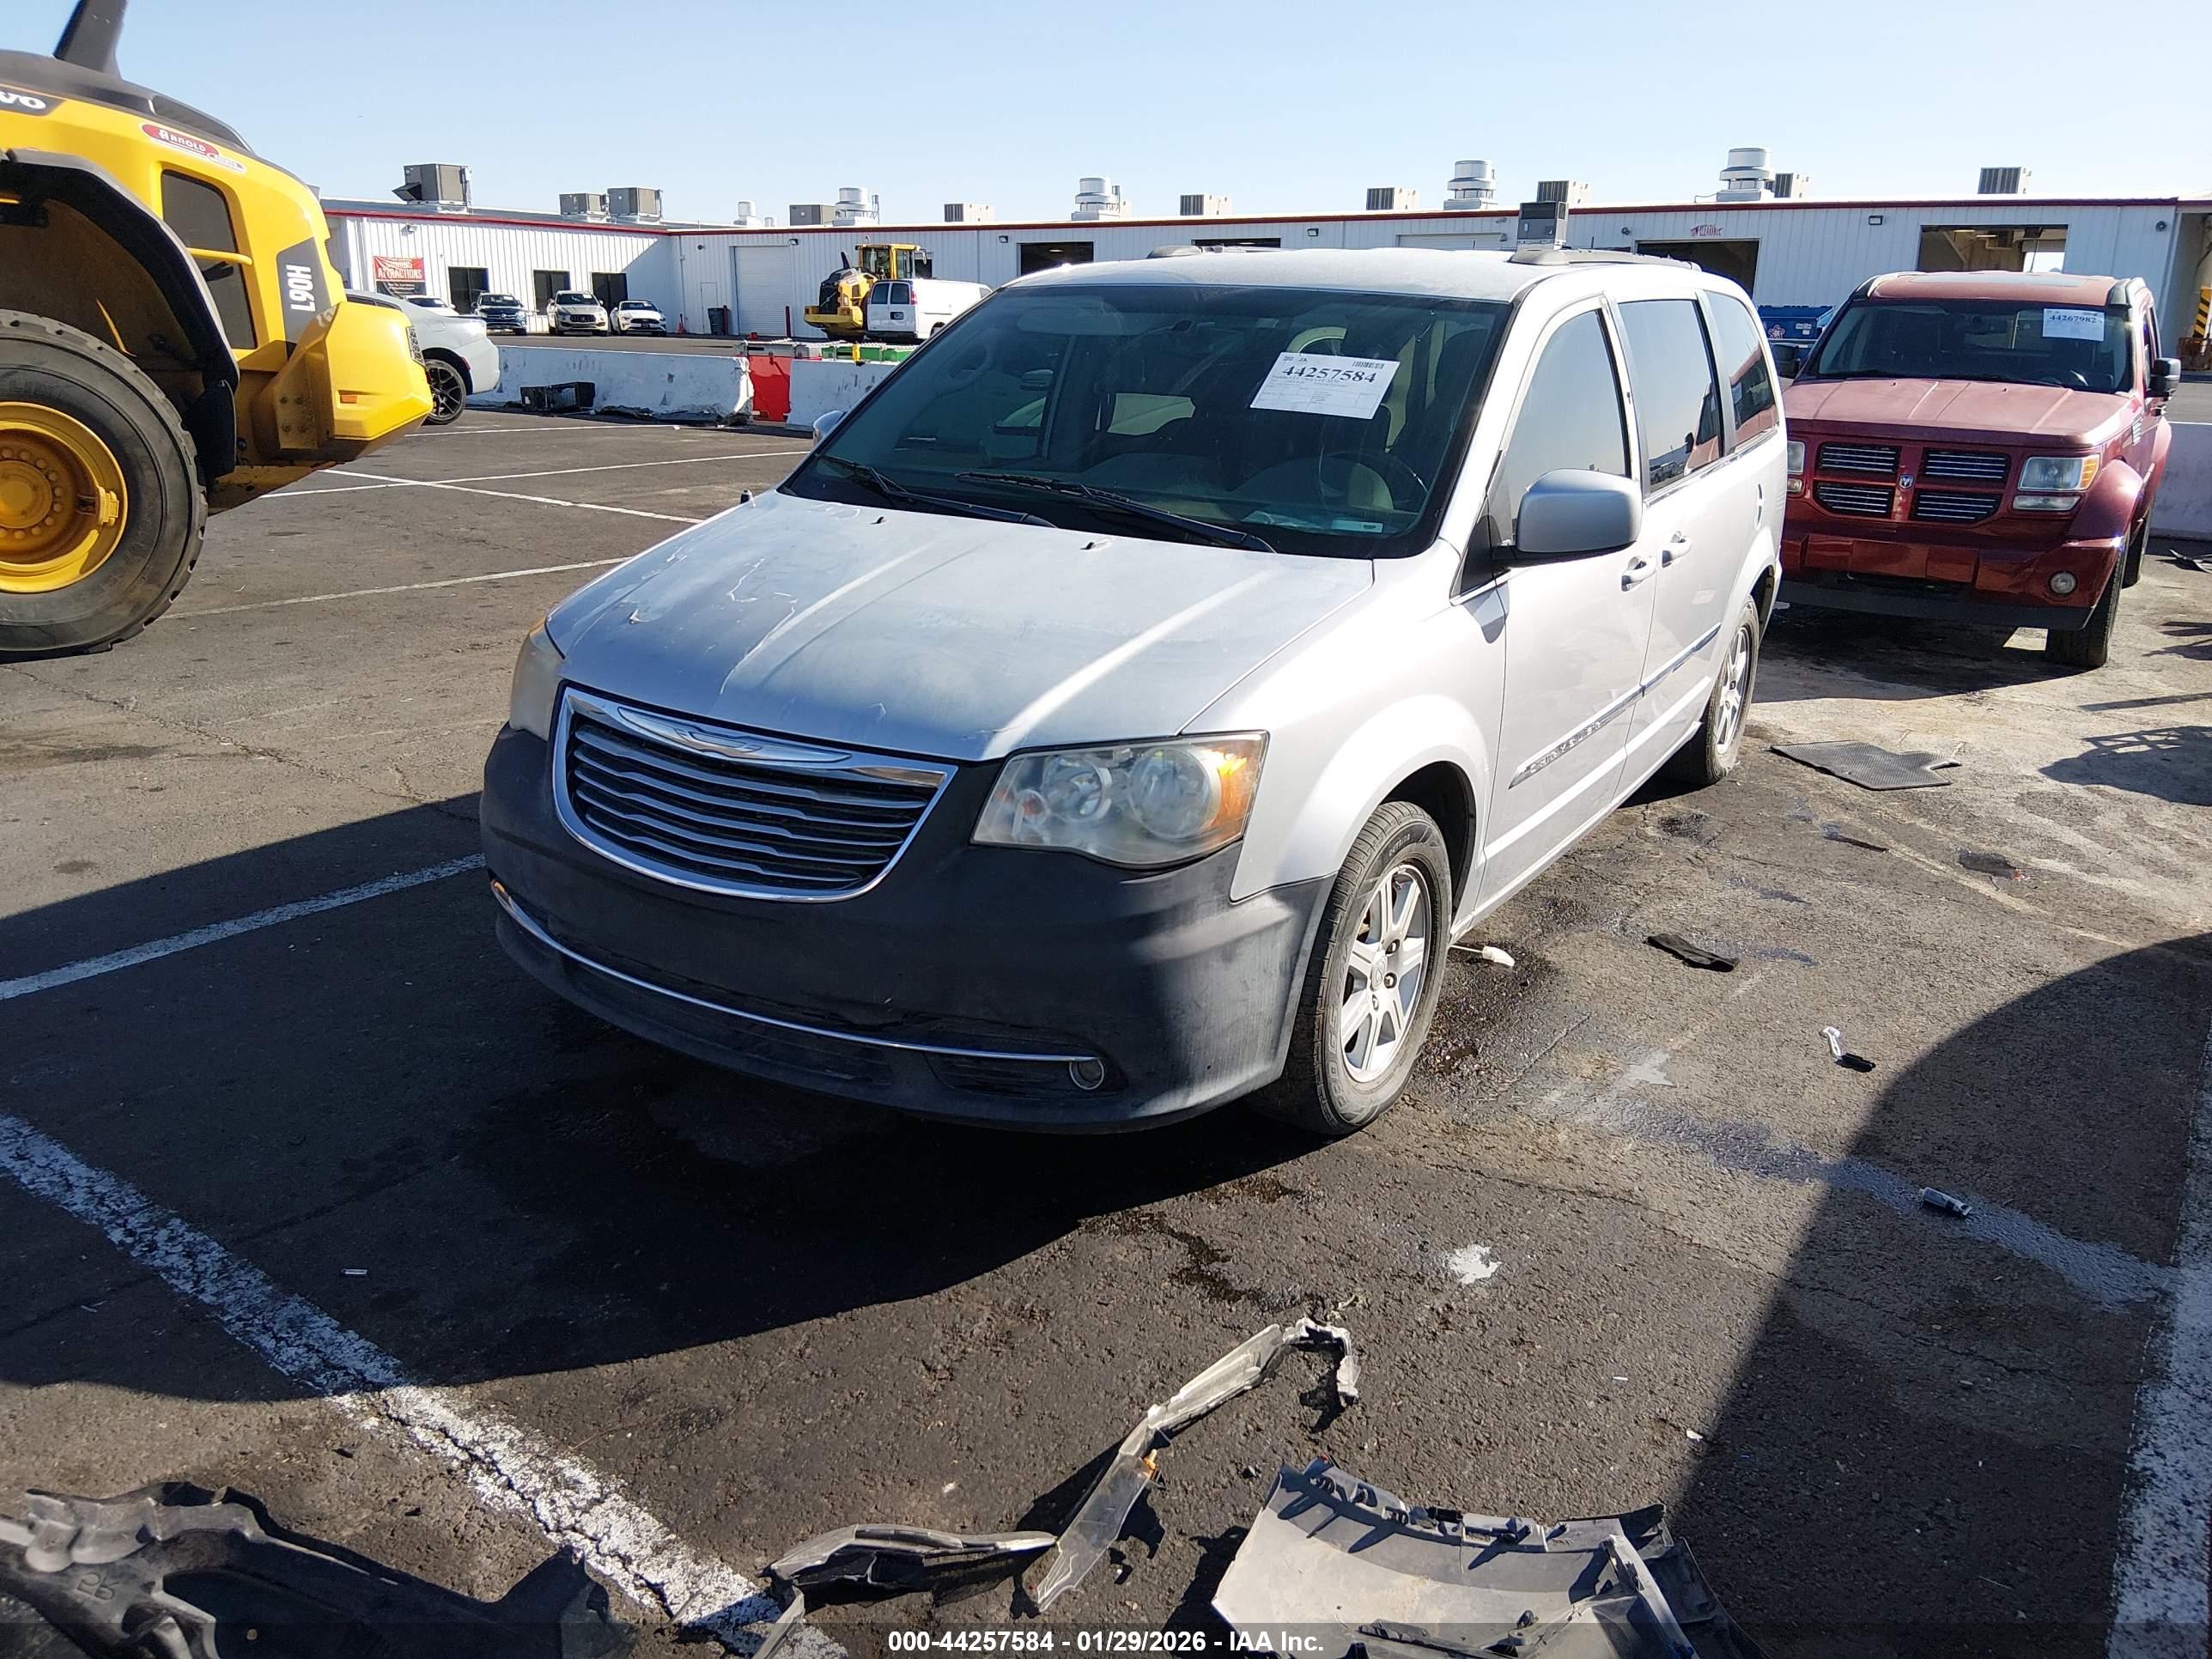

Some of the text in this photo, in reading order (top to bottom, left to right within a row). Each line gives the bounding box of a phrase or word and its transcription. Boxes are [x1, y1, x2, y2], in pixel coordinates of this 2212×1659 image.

[286, 264, 316, 312] L90H
[2049, 314, 2097, 324] 44267982
[1282, 365, 1377, 383] 44257584
